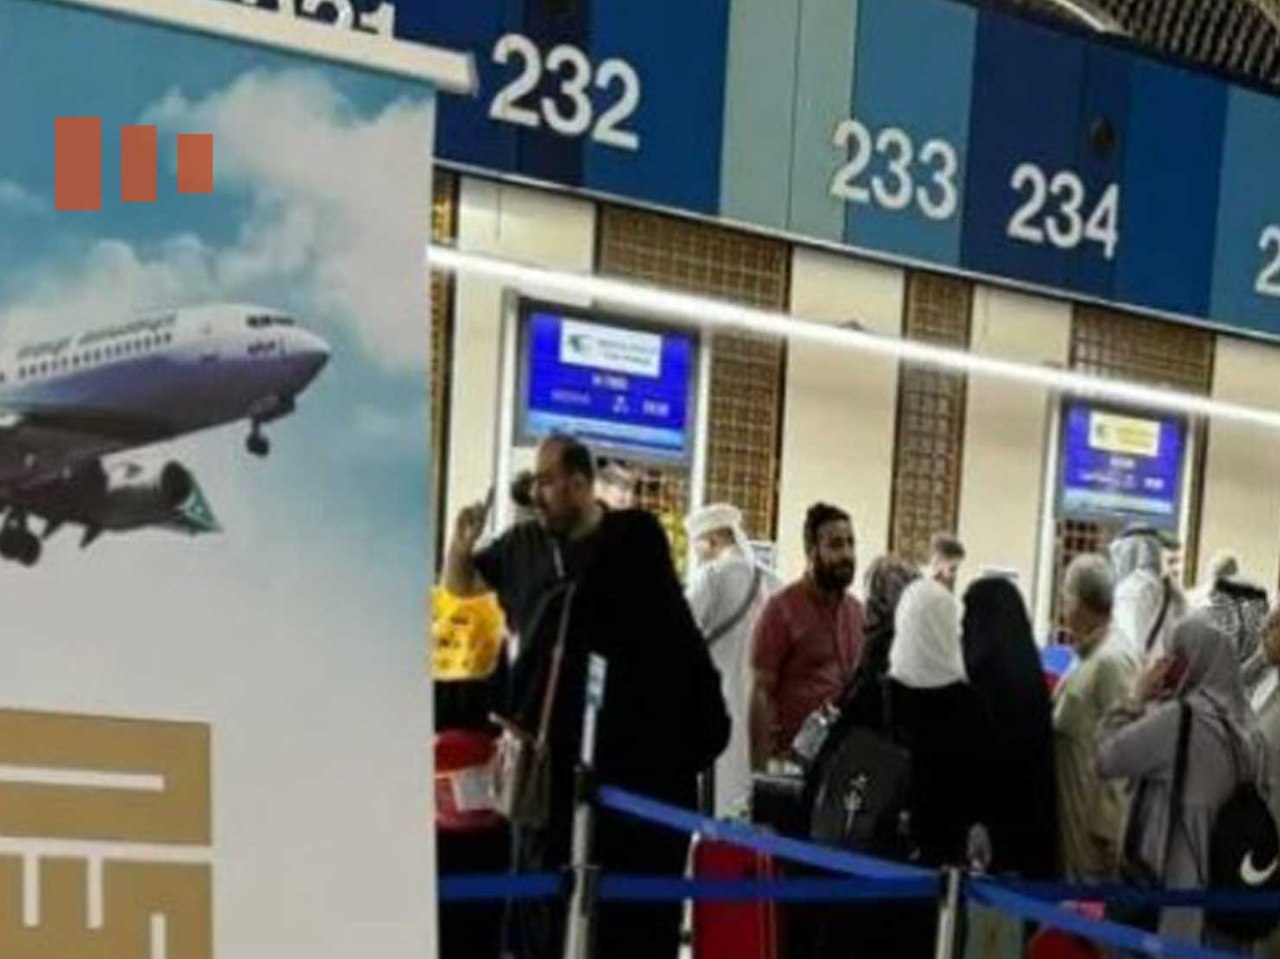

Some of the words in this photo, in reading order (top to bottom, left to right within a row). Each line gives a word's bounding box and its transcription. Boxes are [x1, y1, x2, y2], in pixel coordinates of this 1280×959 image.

[488, 33, 641, 151] 232
[829, 118, 957, 220] 233
[1007, 163, 1118, 259] 234
